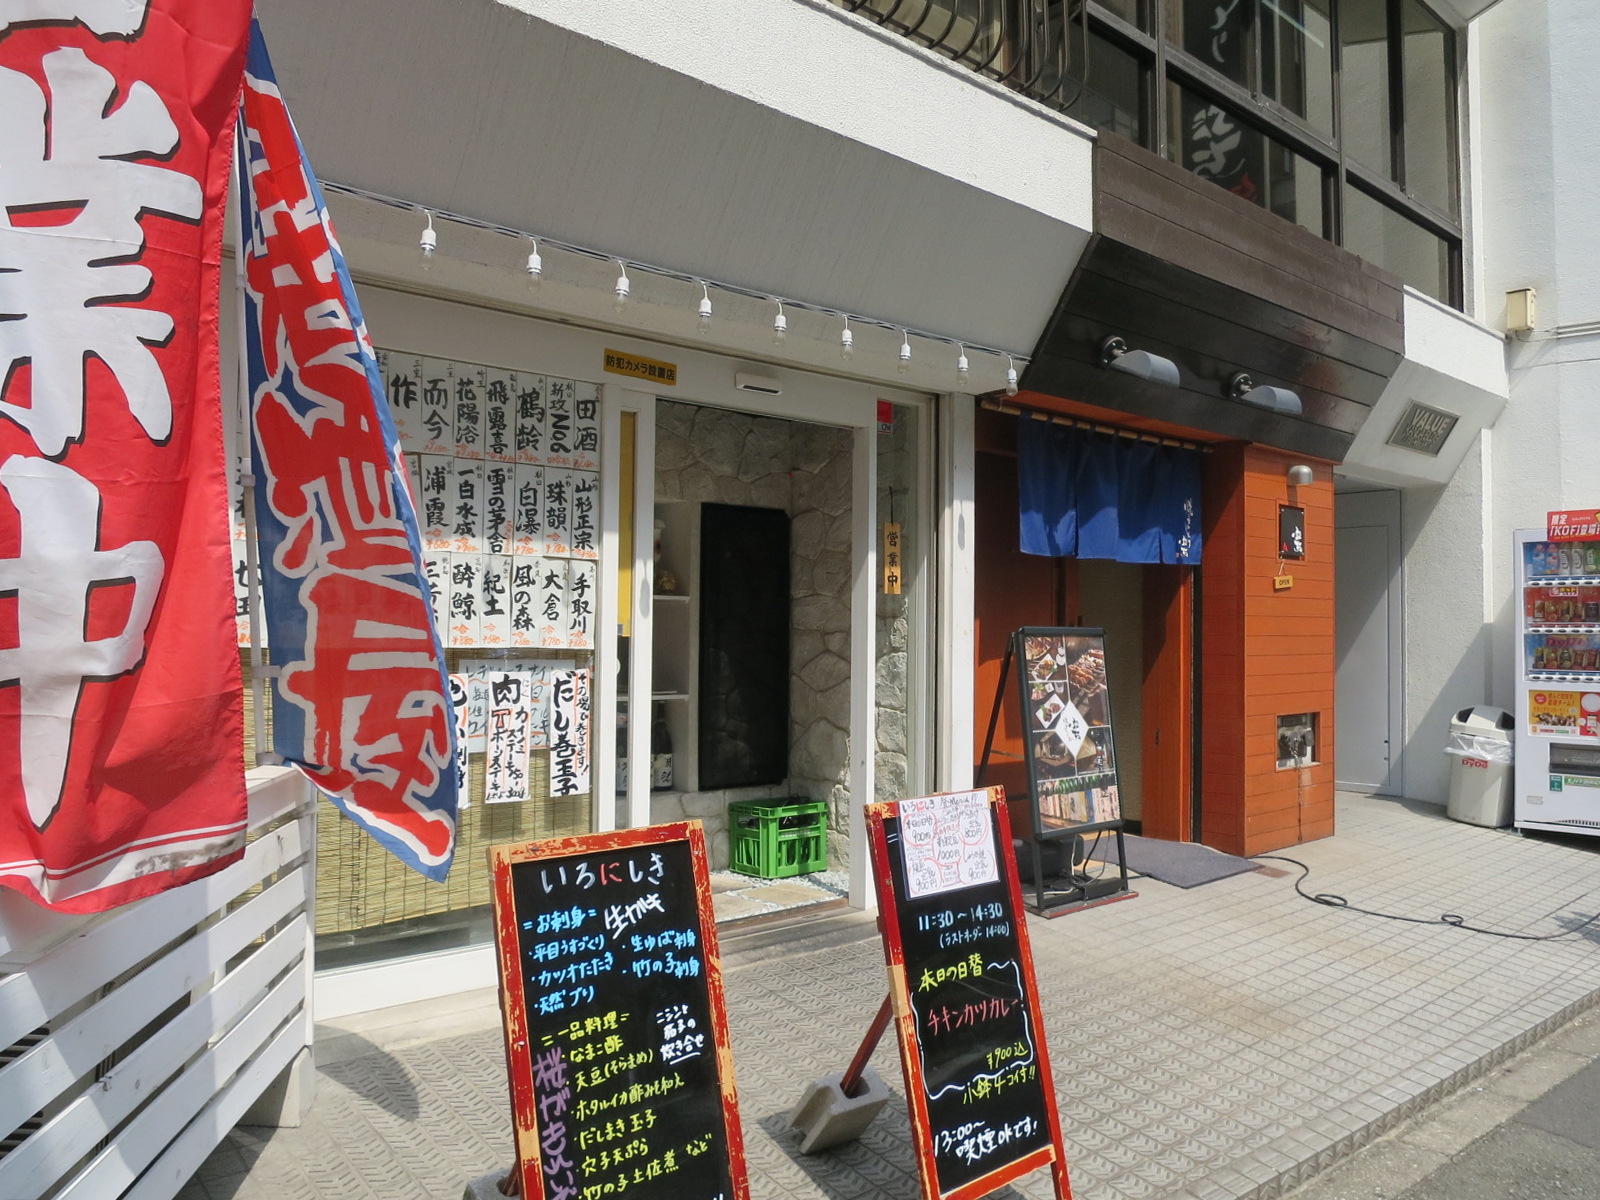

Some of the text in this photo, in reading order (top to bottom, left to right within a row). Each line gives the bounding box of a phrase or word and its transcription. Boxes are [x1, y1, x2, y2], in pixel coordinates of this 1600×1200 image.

[390, 373, 418, 409] 作
[606, 354, 675, 381] 防犯カメラ設置店
[0, 0, 203, 829] 業中
[423, 379, 450, 439] 而今
[456, 377, 480, 444] 花陽浴
[486, 380, 510, 455] 飛露喜
[517, 386, 545, 451] 鶴齢
[573, 399, 598, 453] 田酒
[1411, 409, 1451, 435] VALUE
[424, 466, 450, 528] 浦霞
[453, 468, 478, 538] 一白水成
[487, 467, 508, 553] 雪の茅舎
[516, 481, 541, 535] 白瀑
[546, 480, 569, 533] 珠韻
[573, 478, 594, 550] 山形正宗
[1551, 514, 1568, 525] 限定
[887, 531, 899, 587] 営業中
[451, 562, 477, 620] 酔鯨
[483, 570, 506, 617] 紀土
[512, 564, 536, 631] 風の森
[541, 568, 564, 621] 大倉
[569, 572, 593, 634] 手取川
[453, 623, 470, 634] 一合
[491, 674, 521, 707] 肉
[514, 706, 528, 754] カイノミ
[550, 671, 578, 797] だし巻玉子
[1461, 757, 1488, 769] DyDo
[540, 852, 665, 894] いろにしき
[927, 998, 1019, 1036] チキンカツカレー
[685, 1133, 713, 1156] など
[955, 1116, 1038, 1166] 喫煙OKです!
